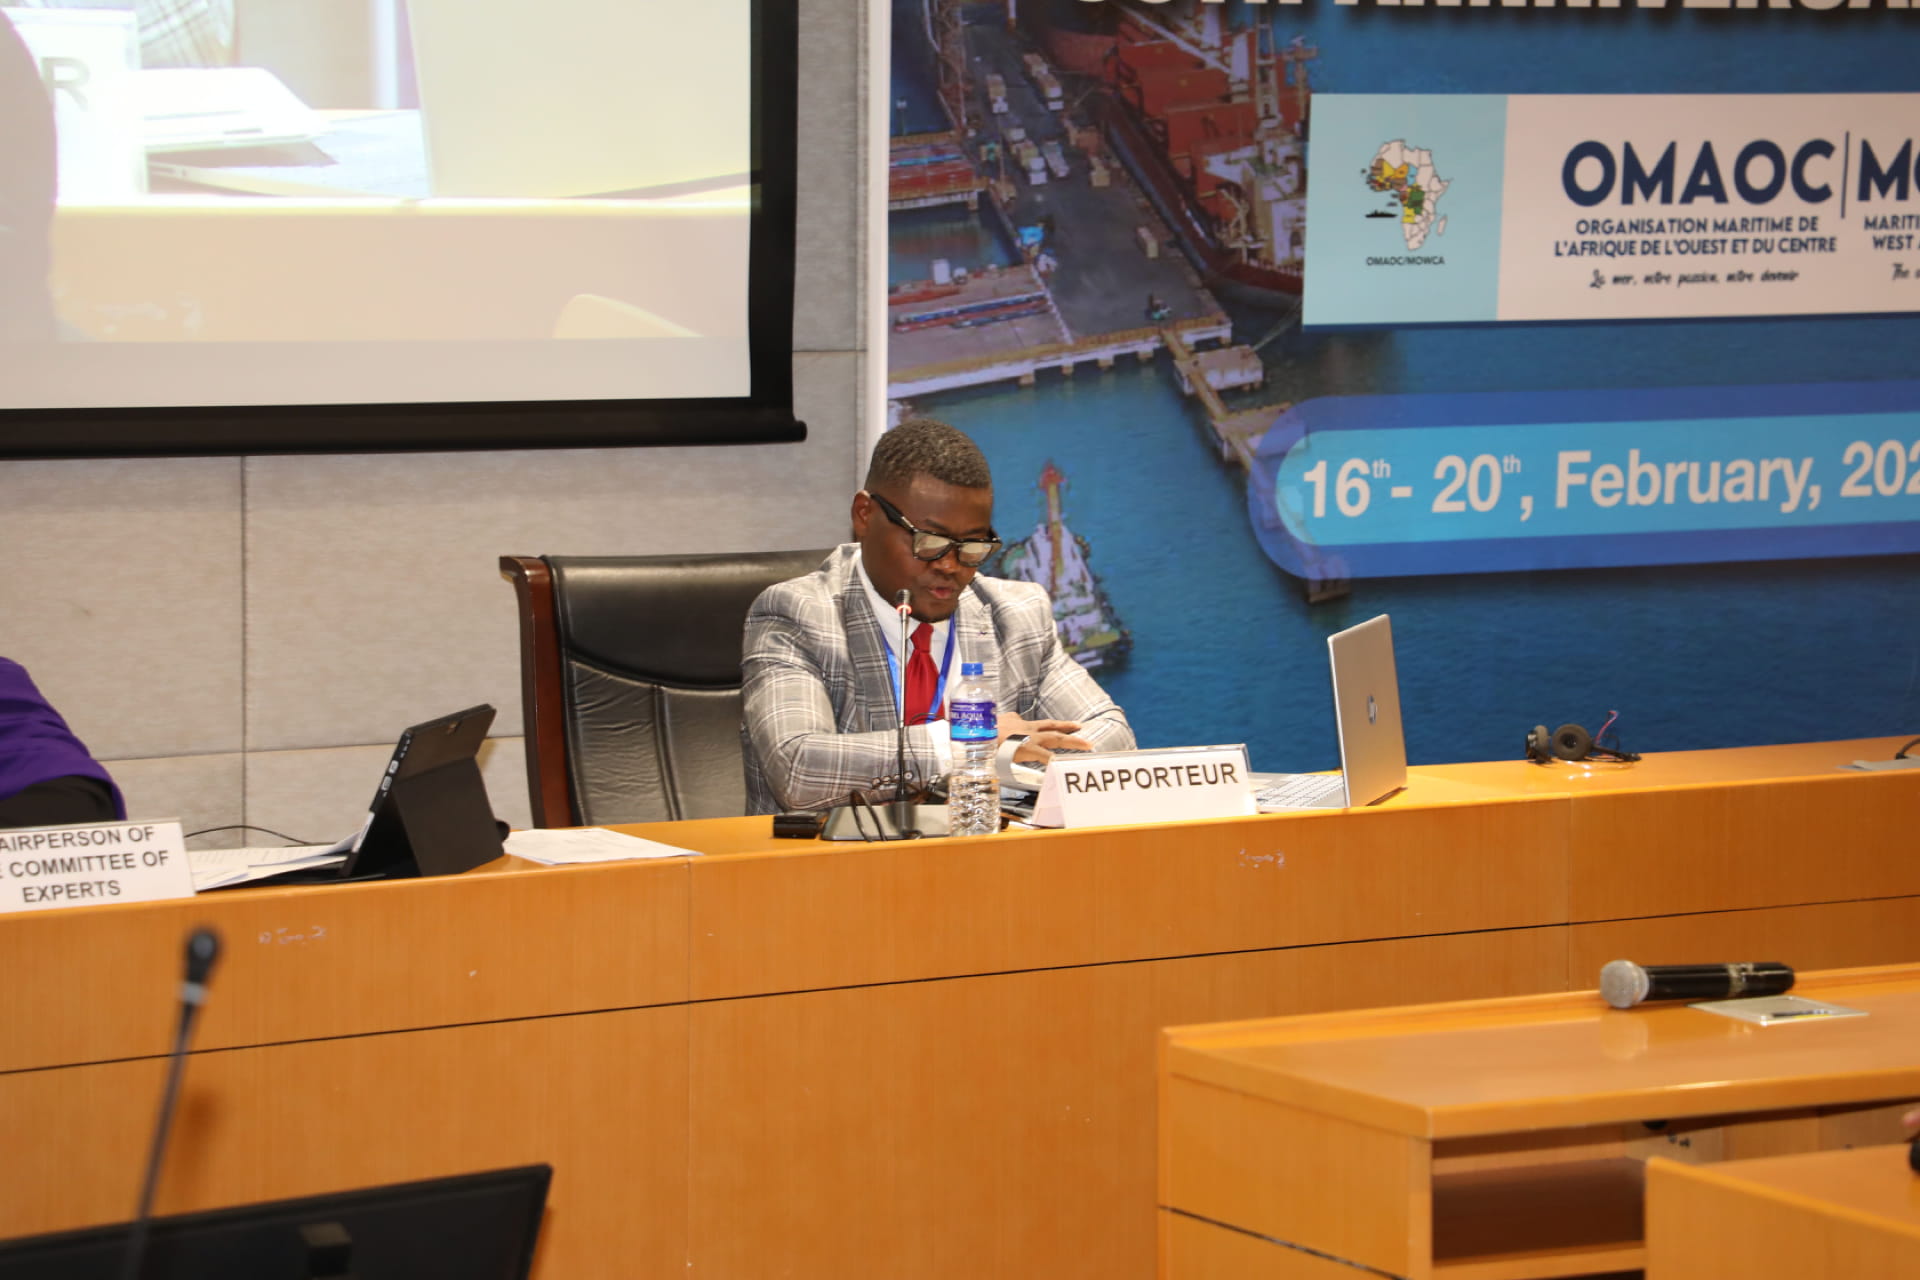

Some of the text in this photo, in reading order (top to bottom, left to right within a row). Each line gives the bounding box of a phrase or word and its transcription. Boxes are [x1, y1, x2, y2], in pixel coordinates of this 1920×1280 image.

[1562, 139, 1836, 207] OMAOC
[1858, 138, 1920, 201] M
[1575, 216, 1818, 235] ORGANISATION MARITIME DE
[1554, 236, 1837, 258] L'AFRIQUE DE L'OUEST ET DU CENTRE
[1872, 234, 1914, 250] WEST
[1555, 448, 1822, 513] February,
[1064, 763, 1239, 794] RAPPORTEUR
[128, 826, 155, 842] OF
[9, 852, 136, 878] COMMITTEE
[143, 850, 169, 867] OF
[22, 880, 121, 903] EXPERTS
